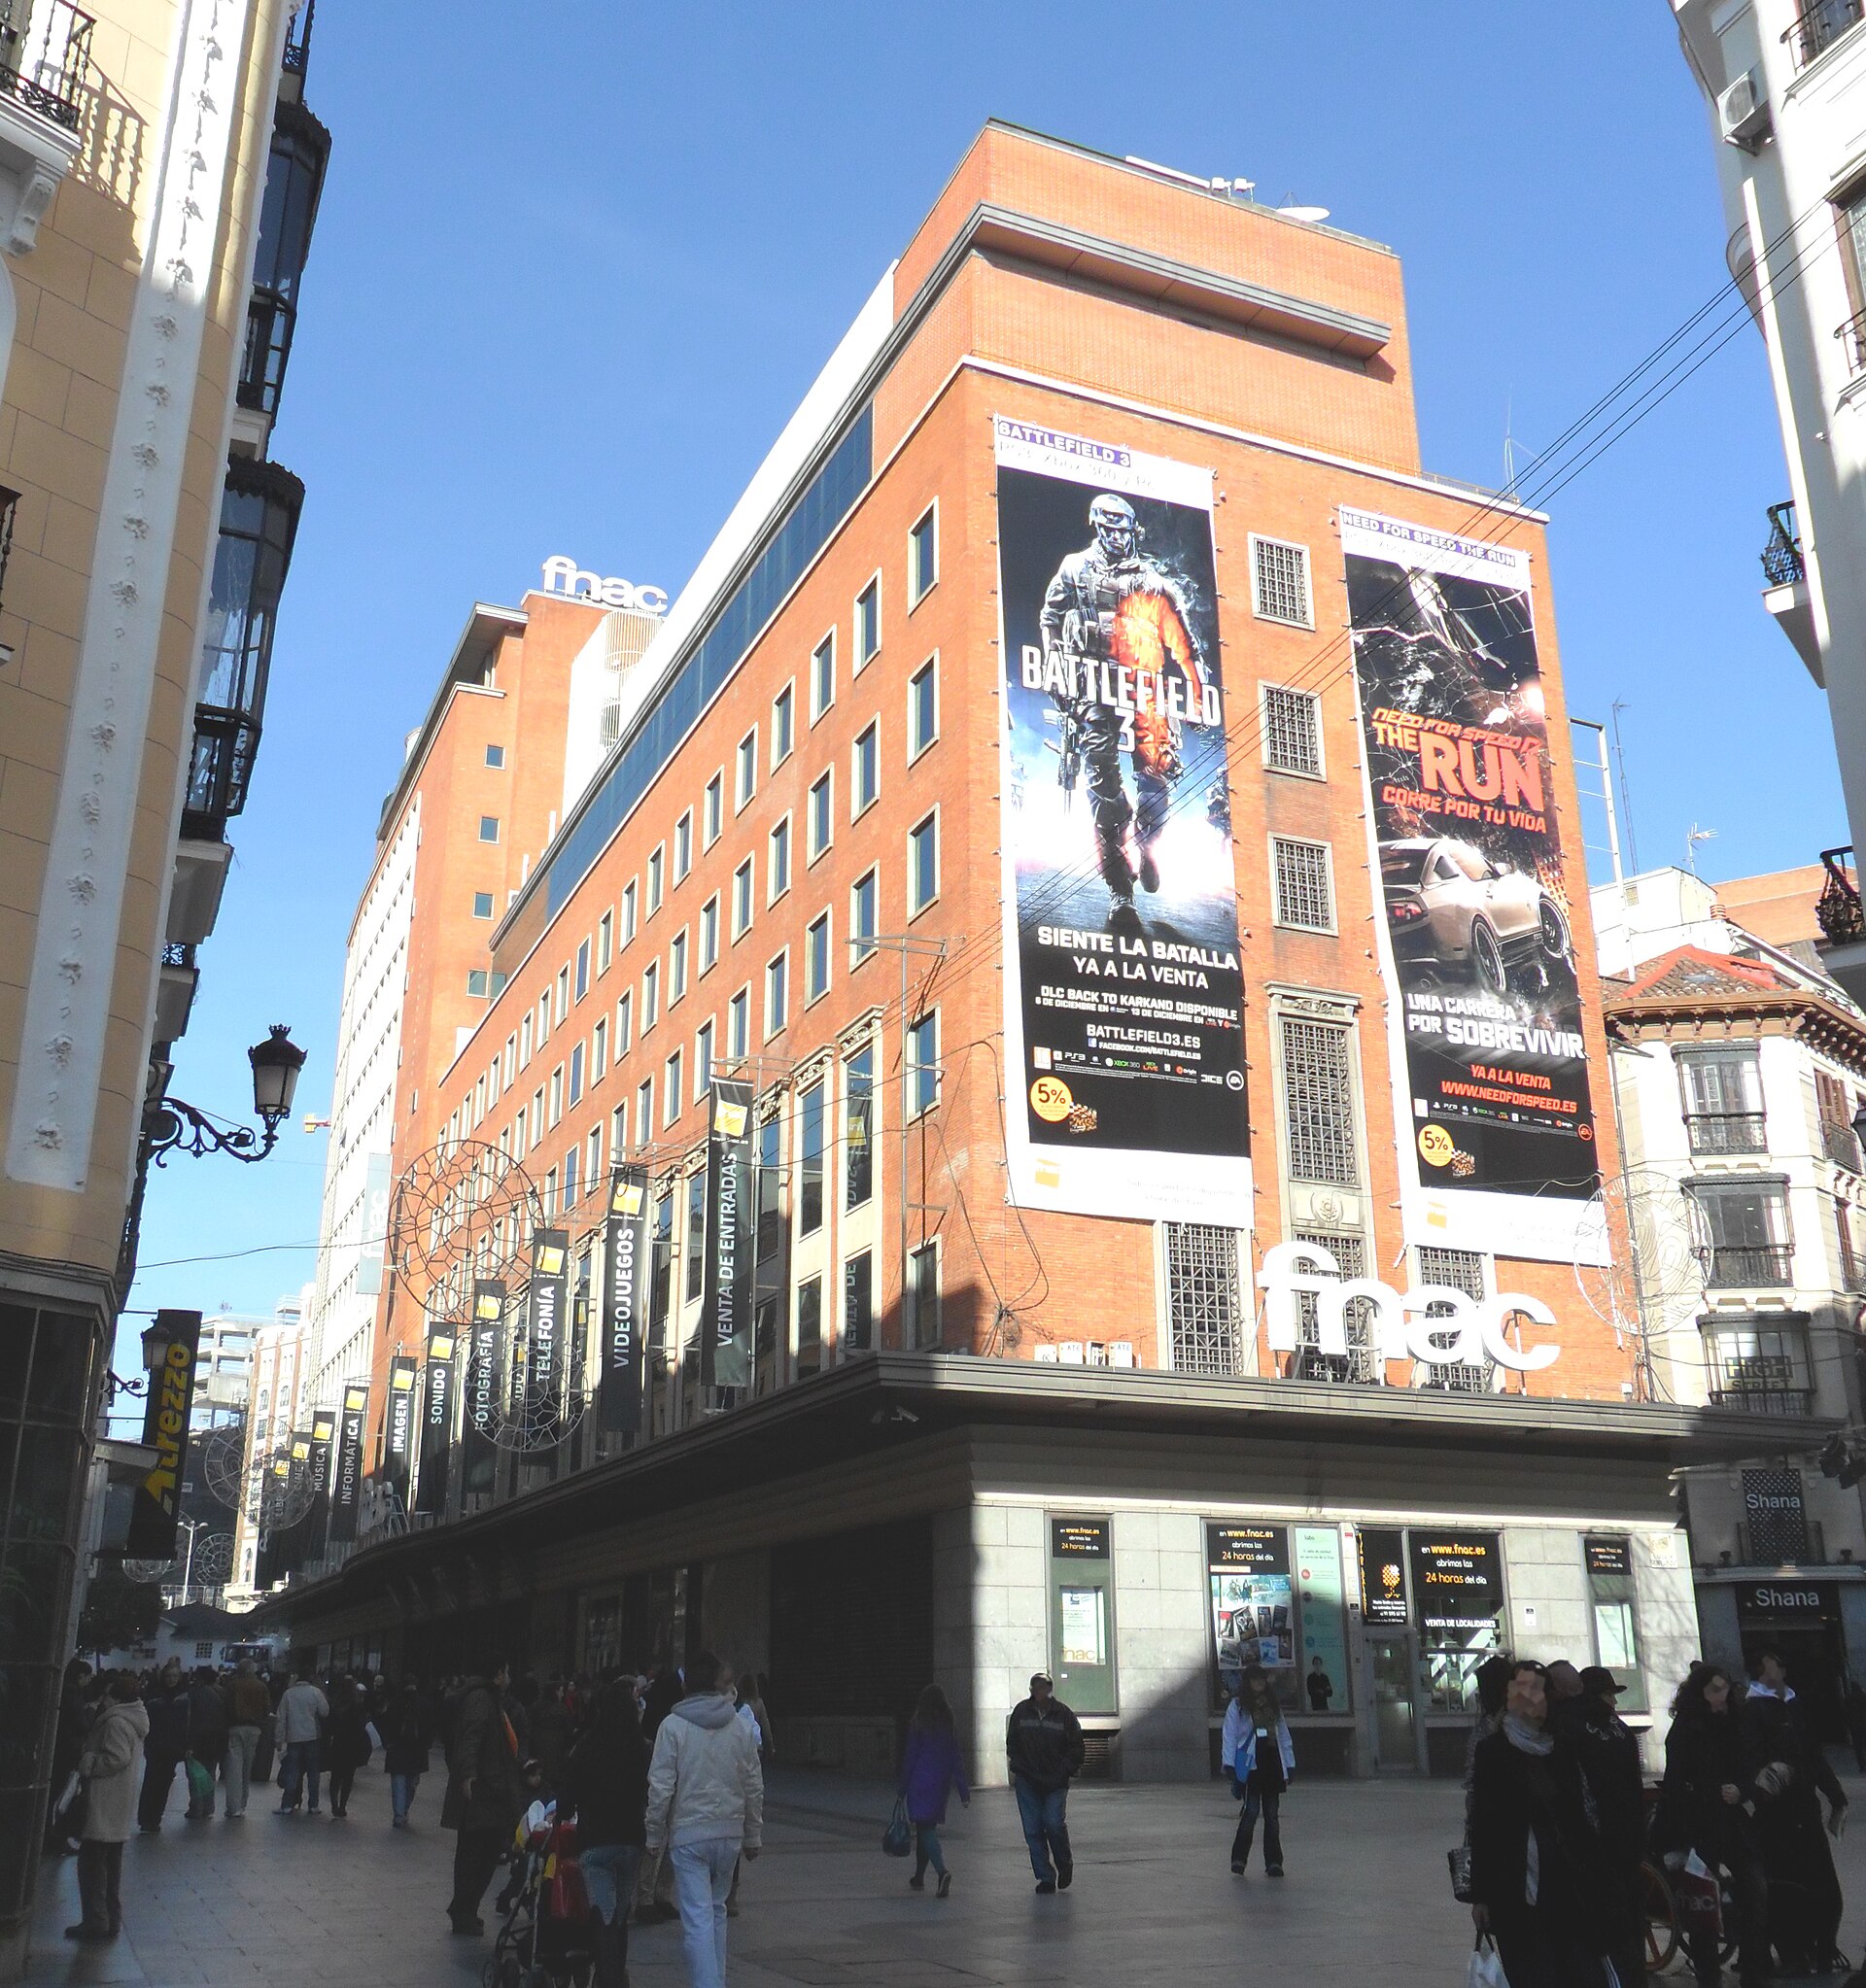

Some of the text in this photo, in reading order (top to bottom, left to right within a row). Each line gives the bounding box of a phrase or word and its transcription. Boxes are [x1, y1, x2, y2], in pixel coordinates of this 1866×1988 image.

[999, 422, 1130, 466] BATTLEFIELD 3
[1342, 513, 1515, 566] NEED FOR SPEED THE RUN
[542, 555, 668, 612] fnac
[1021, 645, 1222, 727] BATTLEFIELD
[1115, 706, 1136, 753] 3
[1372, 721, 1544, 812] THE RUN
[1382, 785, 1546, 834] CORRE POR TU VIDA
[1038, 926, 1239, 972] SIENTE LA BATALLA
[1073, 956, 1209, 989] YA A LA VENTA
[1041, 985, 1238, 1021] DLC BACK TO KARKAND DISPONIBLE
[1043, 998, 1054, 1007] DE
[1054, 999, 1096, 1011] DICIEMBRE
[1097, 1004, 1109, 1012] EN
[1131, 1008, 1140, 1016] 13
[1141, 1009, 1152, 1017] DE
[1154, 1010, 1193, 1023] DICIEMBRE
[1193, 1015, 1204, 1024] EN
[1407, 993, 1517, 1021] UNA CARRERA
[1087, 1023, 1201, 1048] BATTLEFIELD3.ES
[1408, 1014, 1586, 1059] POR SOBREVIVIR
[1065, 1052, 1086, 1061] PS3
[1038, 1083, 1066, 1104] 5%
[1470, 1064, 1552, 1090] YA A LA VENTA
[1441, 1080, 1577, 1114] WWW.NEEDFORSPEED.ES
[1424, 1131, 1448, 1150] 5%
[362, 1188, 388, 1258] fnac
[717, 1152, 738, 1348] VENTA DE ENTRADAS
[613, 1228, 634, 1369] VIDEOJUEGOS
[1257, 1240, 1561, 1371] fnac
[536, 1285, 554, 1382] TELEFONÍA
[475, 1330, 494, 1430] FOTOGRAFÍA
[1727, 1358, 1790, 1378] HIGH
[431, 1368, 446, 1424] SONIDO
[393, 1399, 407, 1453] IMAGEN
[341, 1419, 360, 1504] INFORMÁTICA
[1746, 1493, 1801, 1508] Shana
[1227, 1528, 1274, 1538] www.fnac.es
[1431, 1544, 1486, 1555] www.fnac.es
[1222, 1551, 1231, 1560] 24
[1233, 1552, 1255, 1560] horas
[1436, 1559, 1473, 1568] abrimos las
[1426, 1572, 1436, 1583] 24
[1438, 1572, 1464, 1584] horas
[1465, 1575, 1475, 1584] del
[1756, 1589, 1819, 1606] Shana
[1446, 1619, 1455, 1628] DE
[1456, 1619, 1496, 1628] LOCALIDADES
